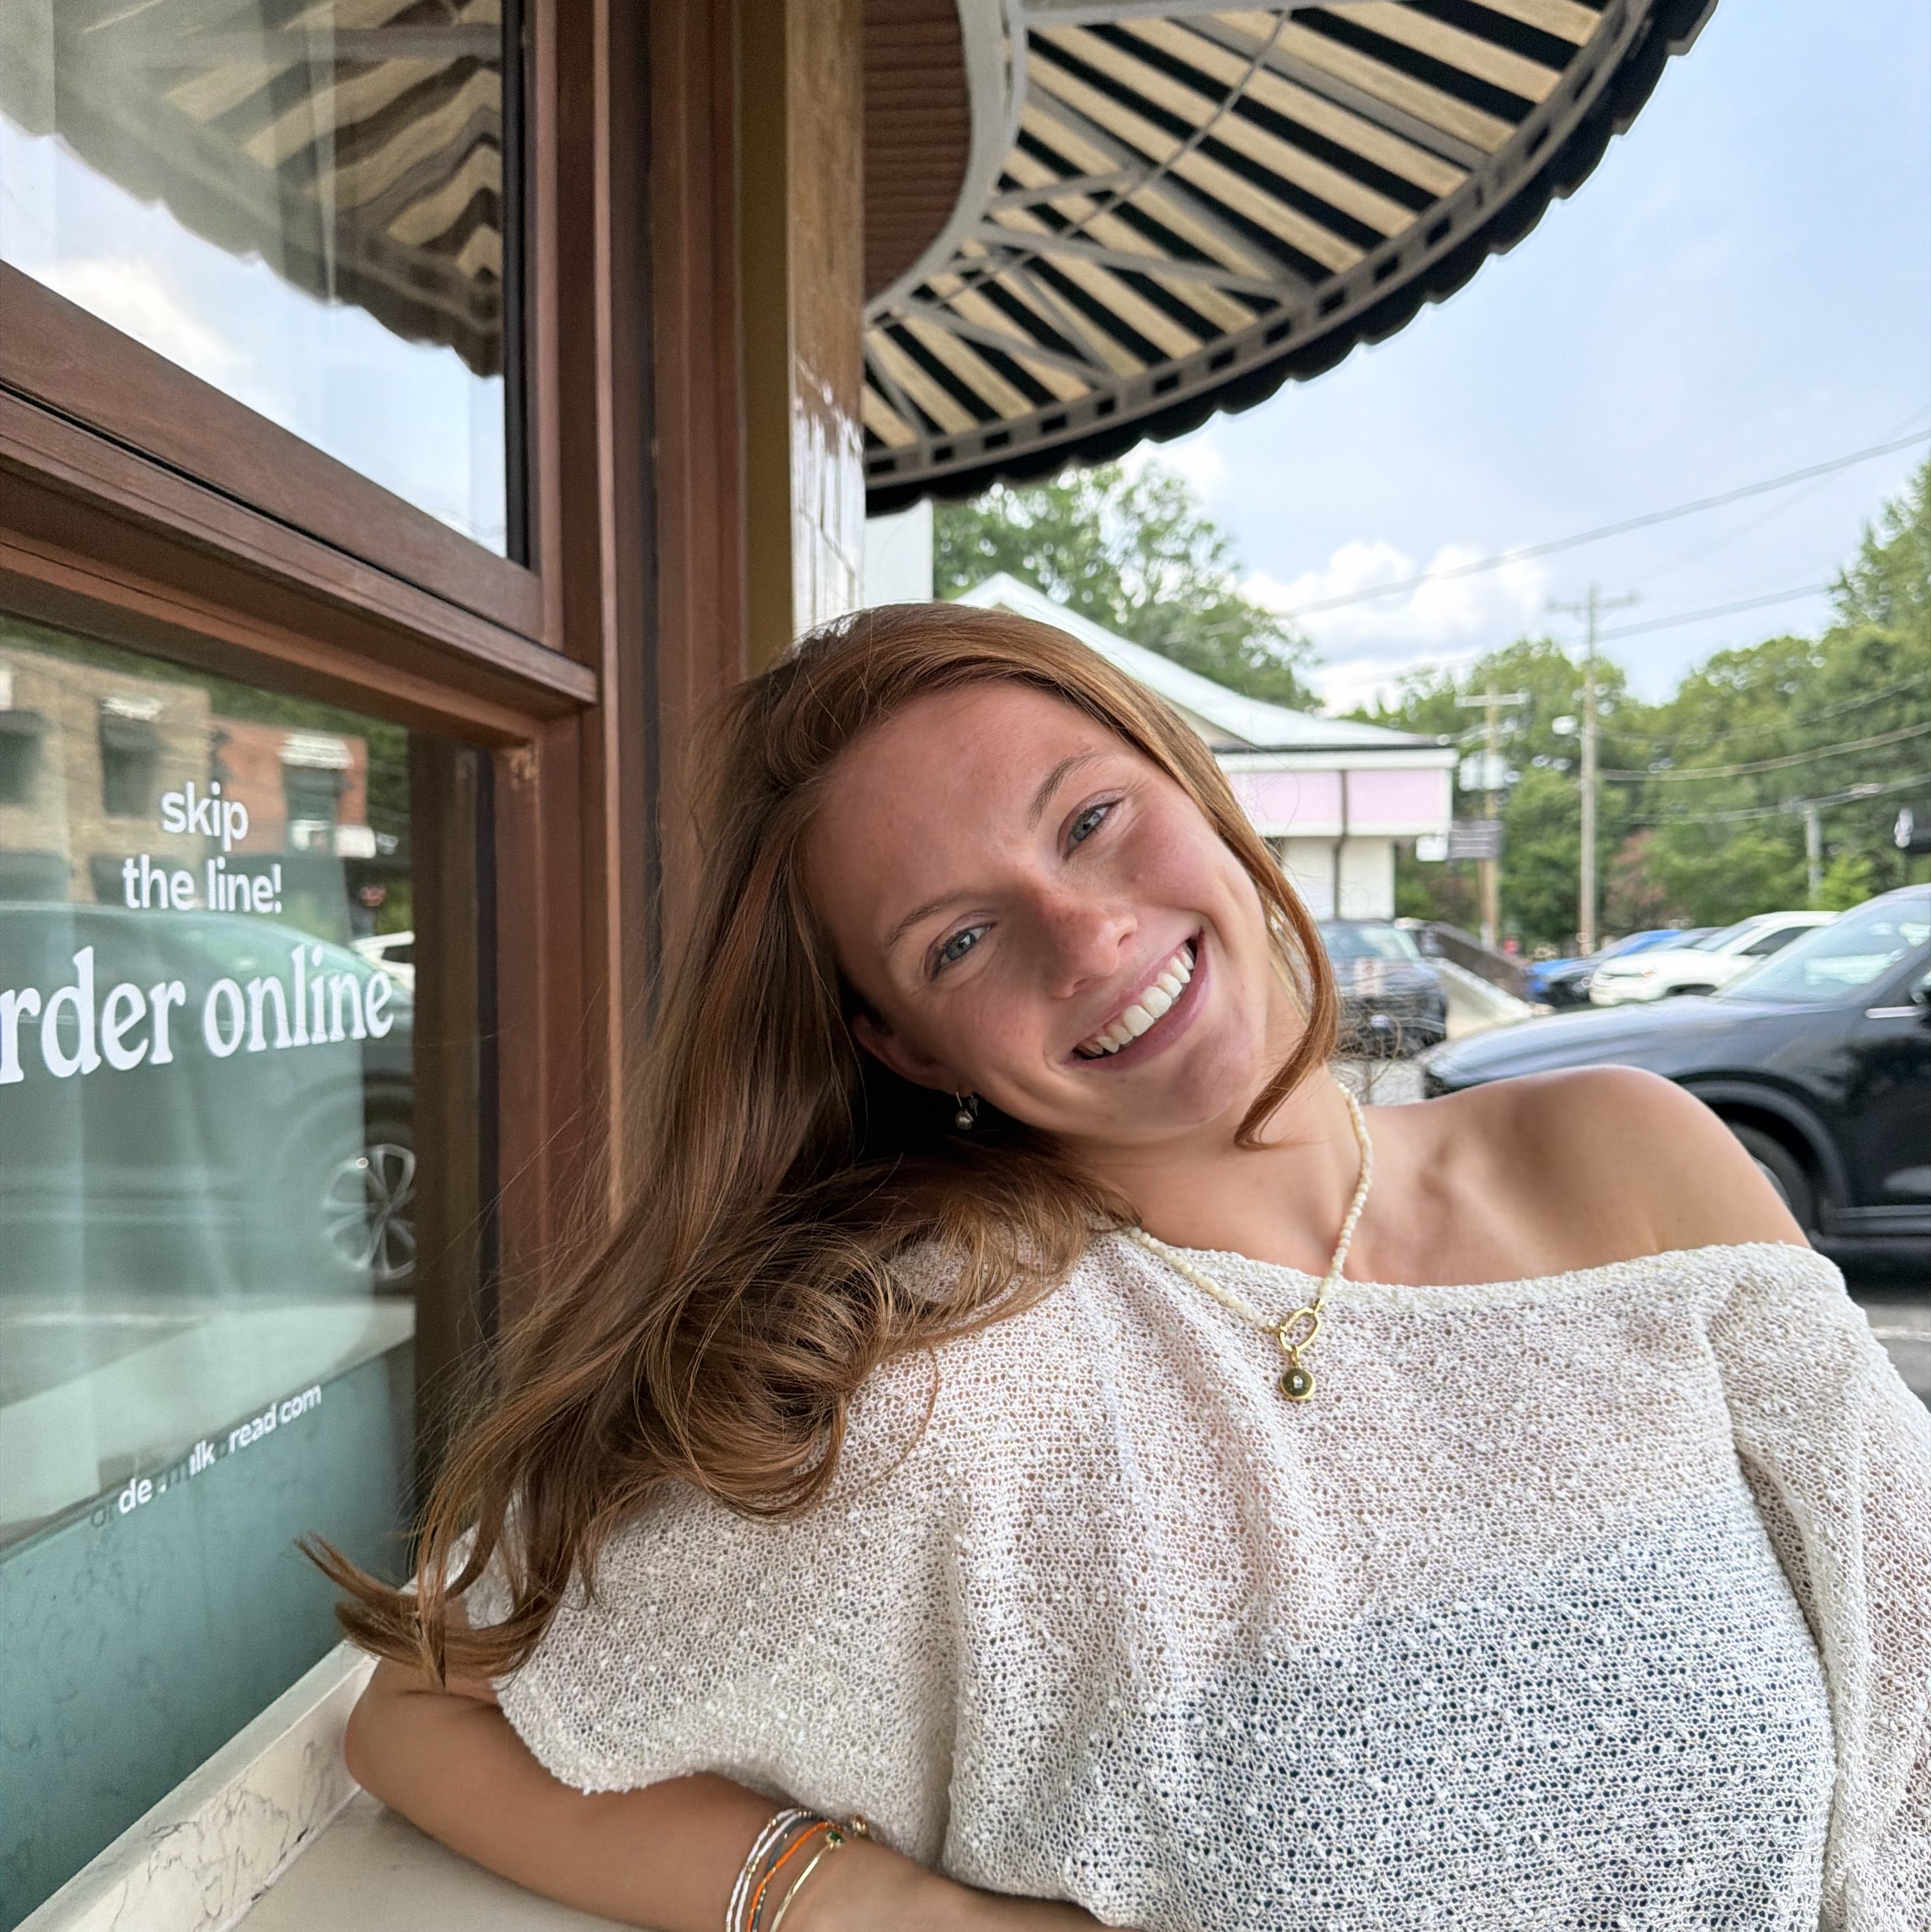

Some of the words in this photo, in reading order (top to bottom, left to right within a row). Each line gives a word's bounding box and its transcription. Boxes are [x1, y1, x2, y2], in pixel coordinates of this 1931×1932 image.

[161, 781, 248, 852] skip
[122, 854, 193, 910] the
[206, 856, 282, 914] line!
[203, 944, 395, 1058] online
